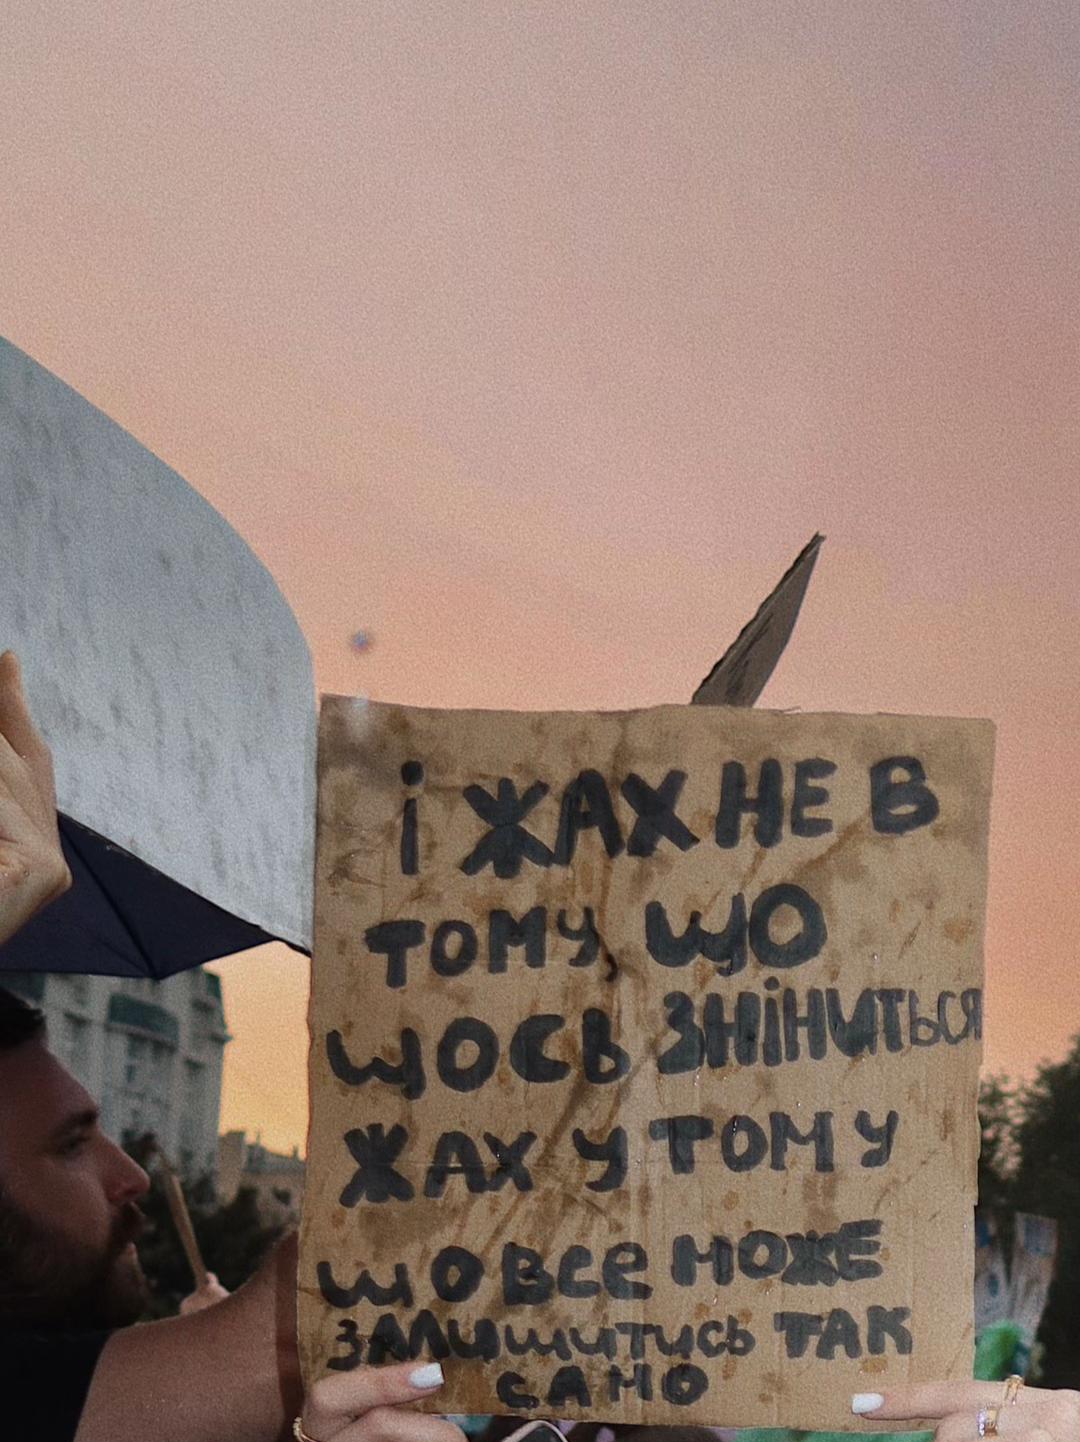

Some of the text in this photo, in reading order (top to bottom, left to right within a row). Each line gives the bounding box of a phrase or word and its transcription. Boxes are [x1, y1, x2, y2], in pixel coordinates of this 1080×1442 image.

[461, 769, 699, 878] ЖАХ
[714, 756, 837, 850] НЕ
[868, 755, 940, 836] В
[364, 883, 828, 989] ТОМУ ЩО
[326, 1008, 631, 1101] ЩОСЬ
[339, 1108, 899, 1208] ЖАХ У ТОМУ
[773, 1304, 914, 1361] ТАК
